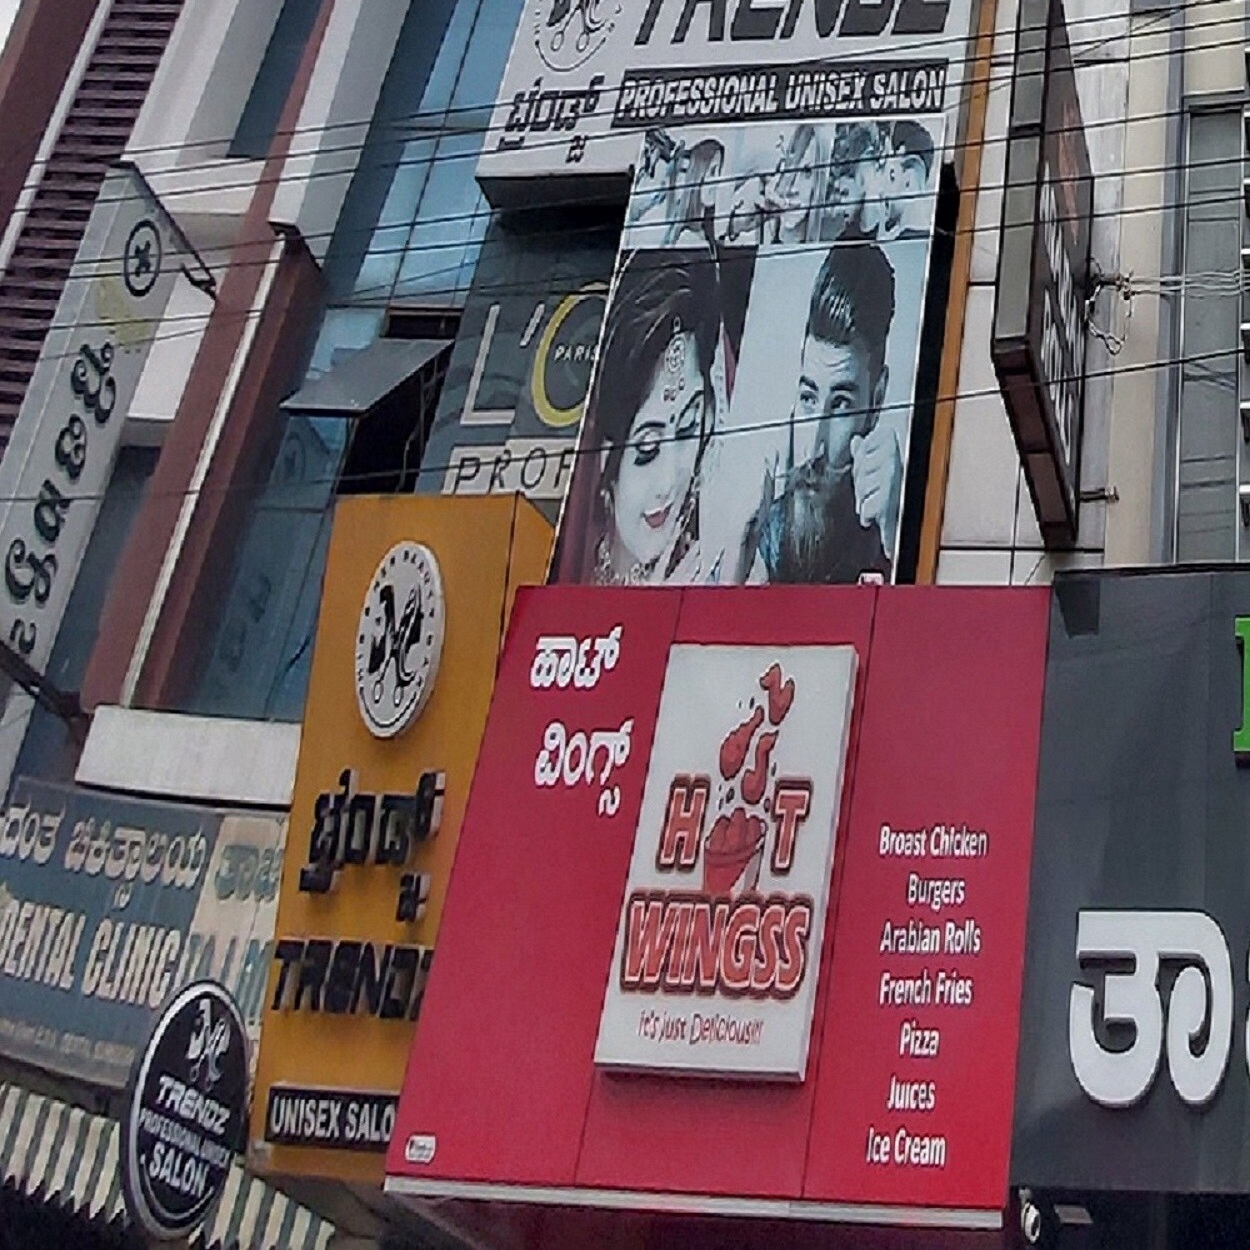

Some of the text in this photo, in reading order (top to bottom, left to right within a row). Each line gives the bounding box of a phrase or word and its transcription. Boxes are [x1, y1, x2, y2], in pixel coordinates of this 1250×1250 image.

[617, 67, 947, 119] PROFESSIONAL UNISEX SALON
[879, 824, 988, 857] Broast Chicken
[908, 873, 966, 911] Burgers
[0, 899, 87, 991] DENTAL
[80, 917, 182, 1010] CLINIC
[620, 892, 813, 999] WINGSS
[880, 919, 981, 954] Arabian Rolls
[880, 968, 973, 1006] French Fries
[899, 1018, 940, 1057] Pizza
[155, 1073, 232, 1136] TRENDZ
[886, 1073, 937, 1111] Juices
[271, 1095, 341, 1140] UNISEX
[866, 1126, 947, 1167] Ice Cream
[149, 1140, 210, 1199] SALON
